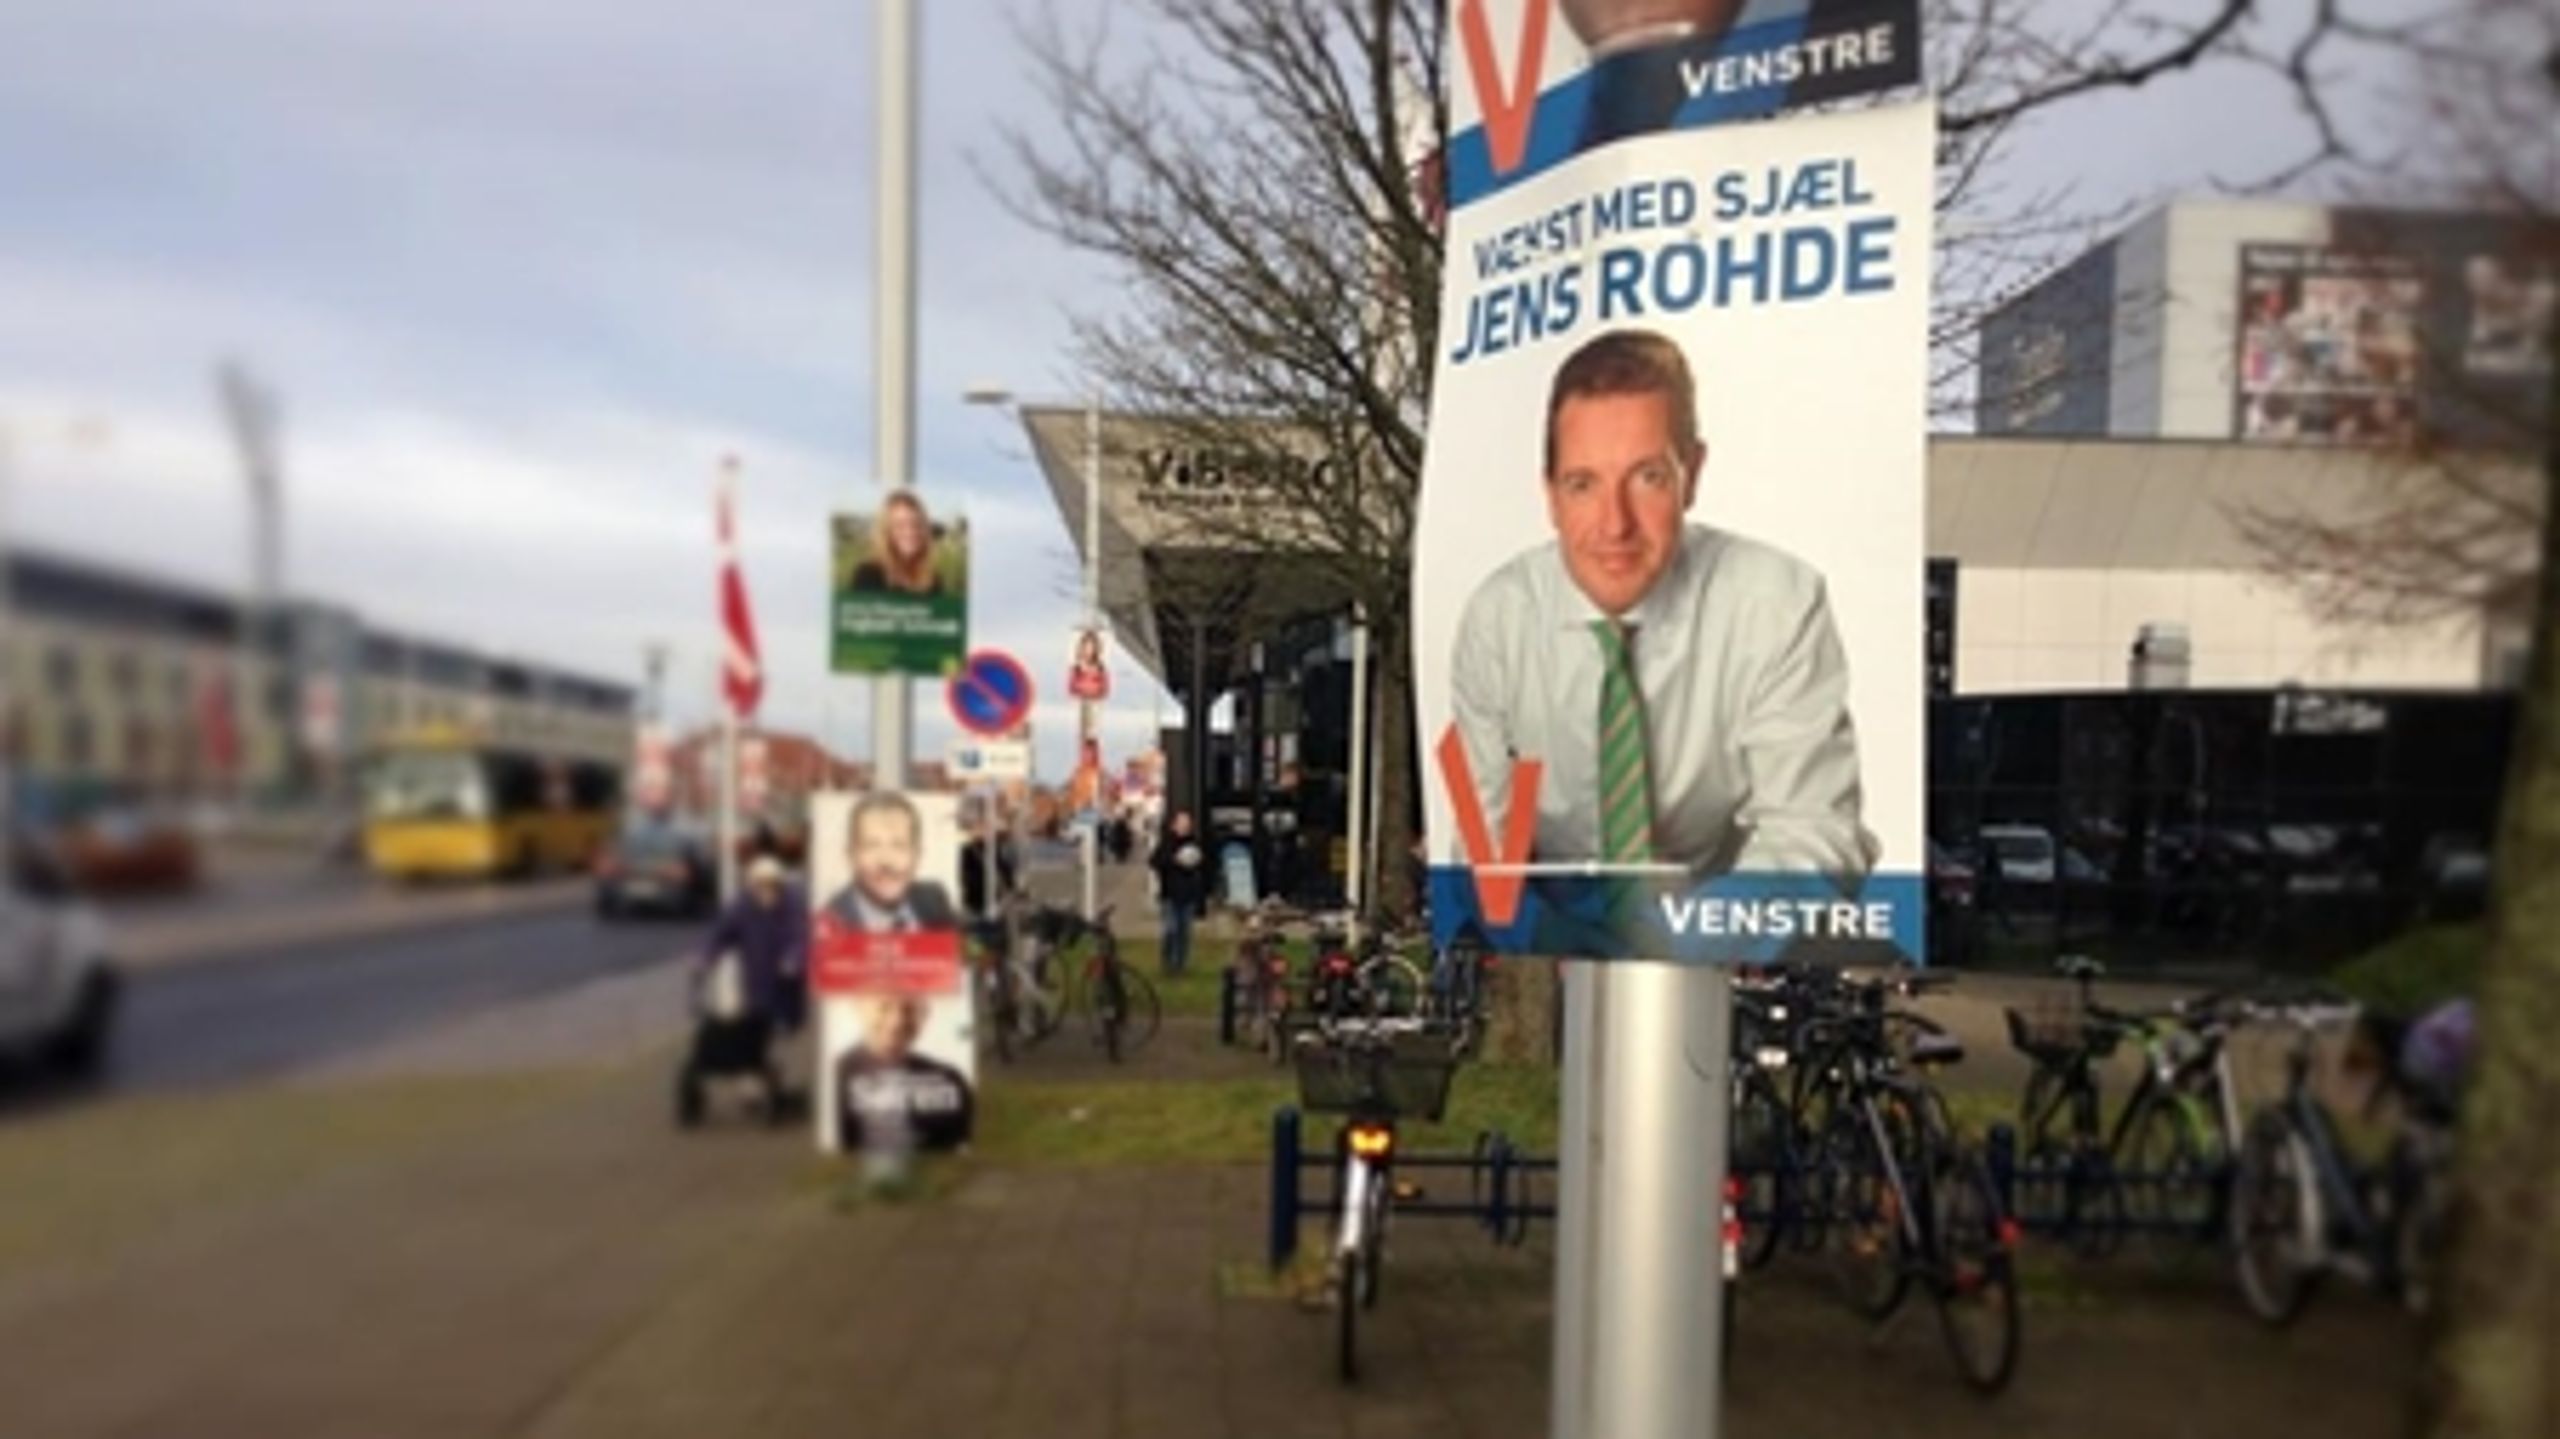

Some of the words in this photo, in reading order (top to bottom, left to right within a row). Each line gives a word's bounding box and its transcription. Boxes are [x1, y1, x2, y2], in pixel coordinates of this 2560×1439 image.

[1679, 24, 1896, 98] VENSTRE
[1591, 180, 1697, 240] MED
[1713, 157, 1873, 222] SJÆL
[1450, 264, 1582, 365] JENS
[1597, 217, 1897, 321] ROHDE
[1660, 891, 1895, 942] VENSTRE
